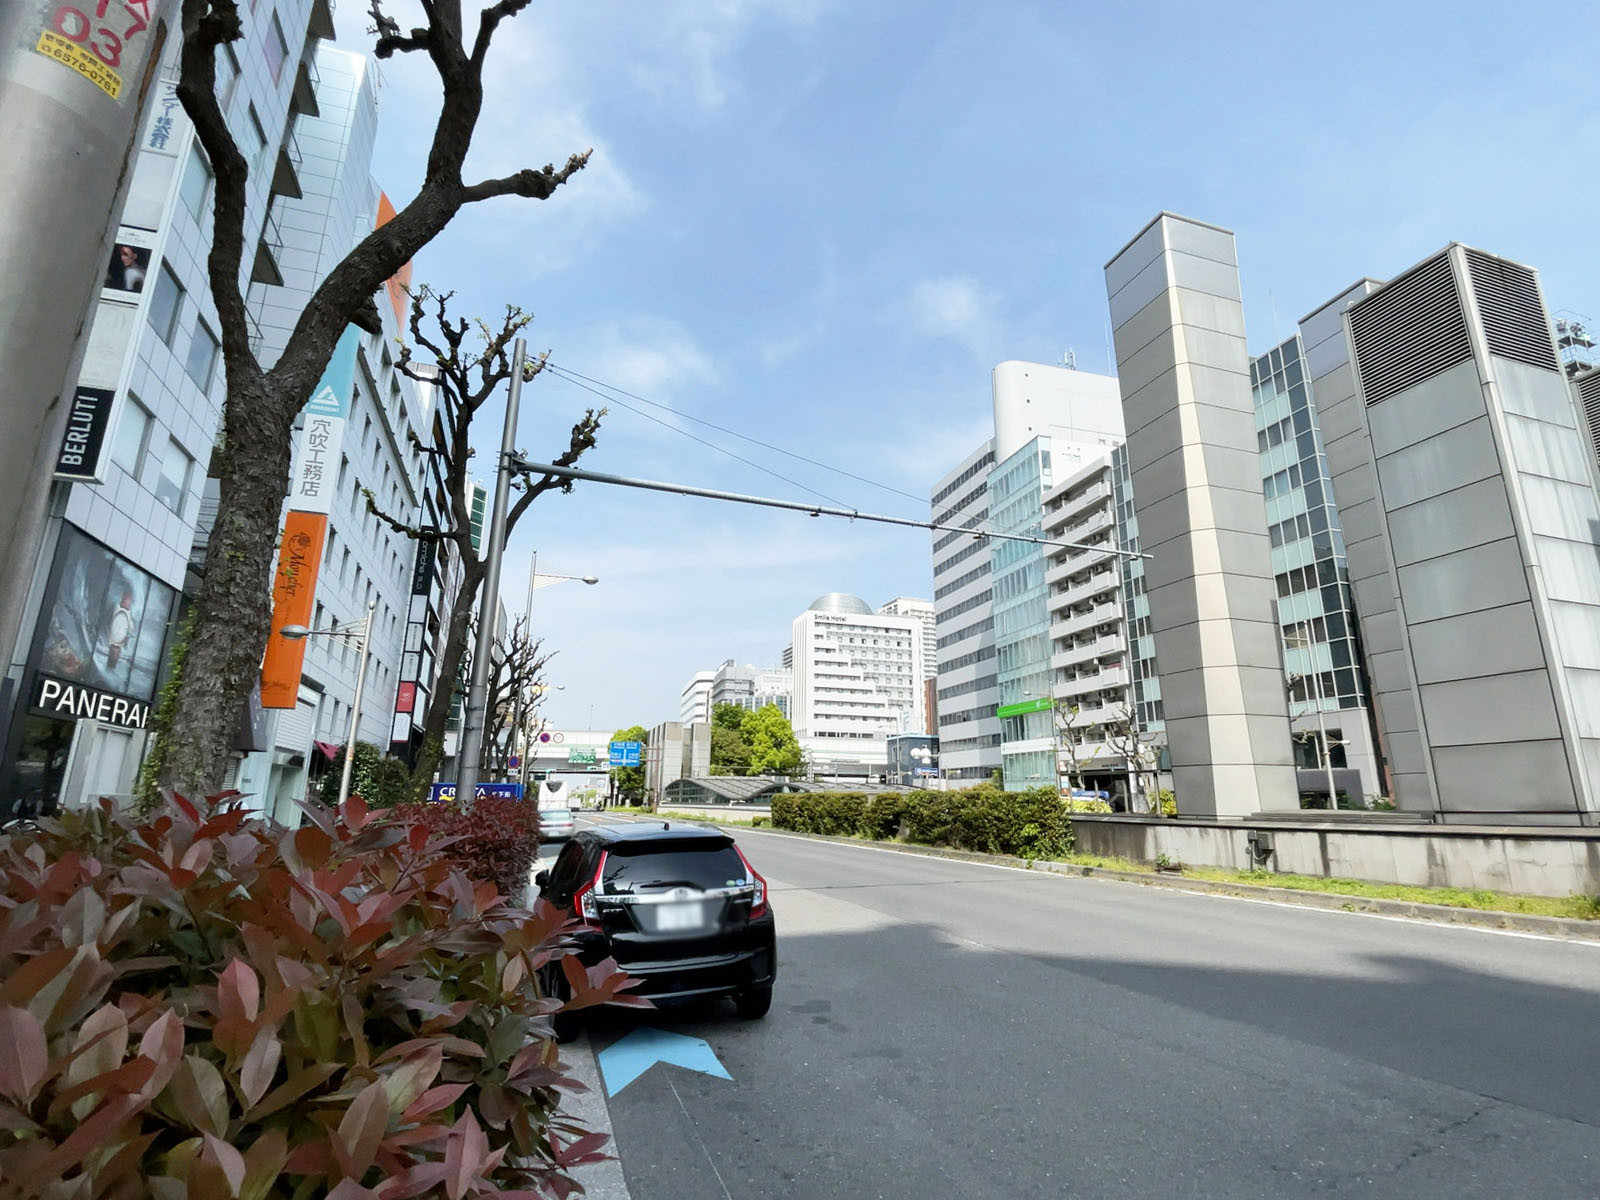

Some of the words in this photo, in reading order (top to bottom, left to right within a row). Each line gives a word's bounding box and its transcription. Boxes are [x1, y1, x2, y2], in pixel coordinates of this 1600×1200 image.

[61, 395, 98, 466] BERLUTI
[300, 419, 331, 497] 穴吹工務店
[39, 679, 149, 728] PANERAI
